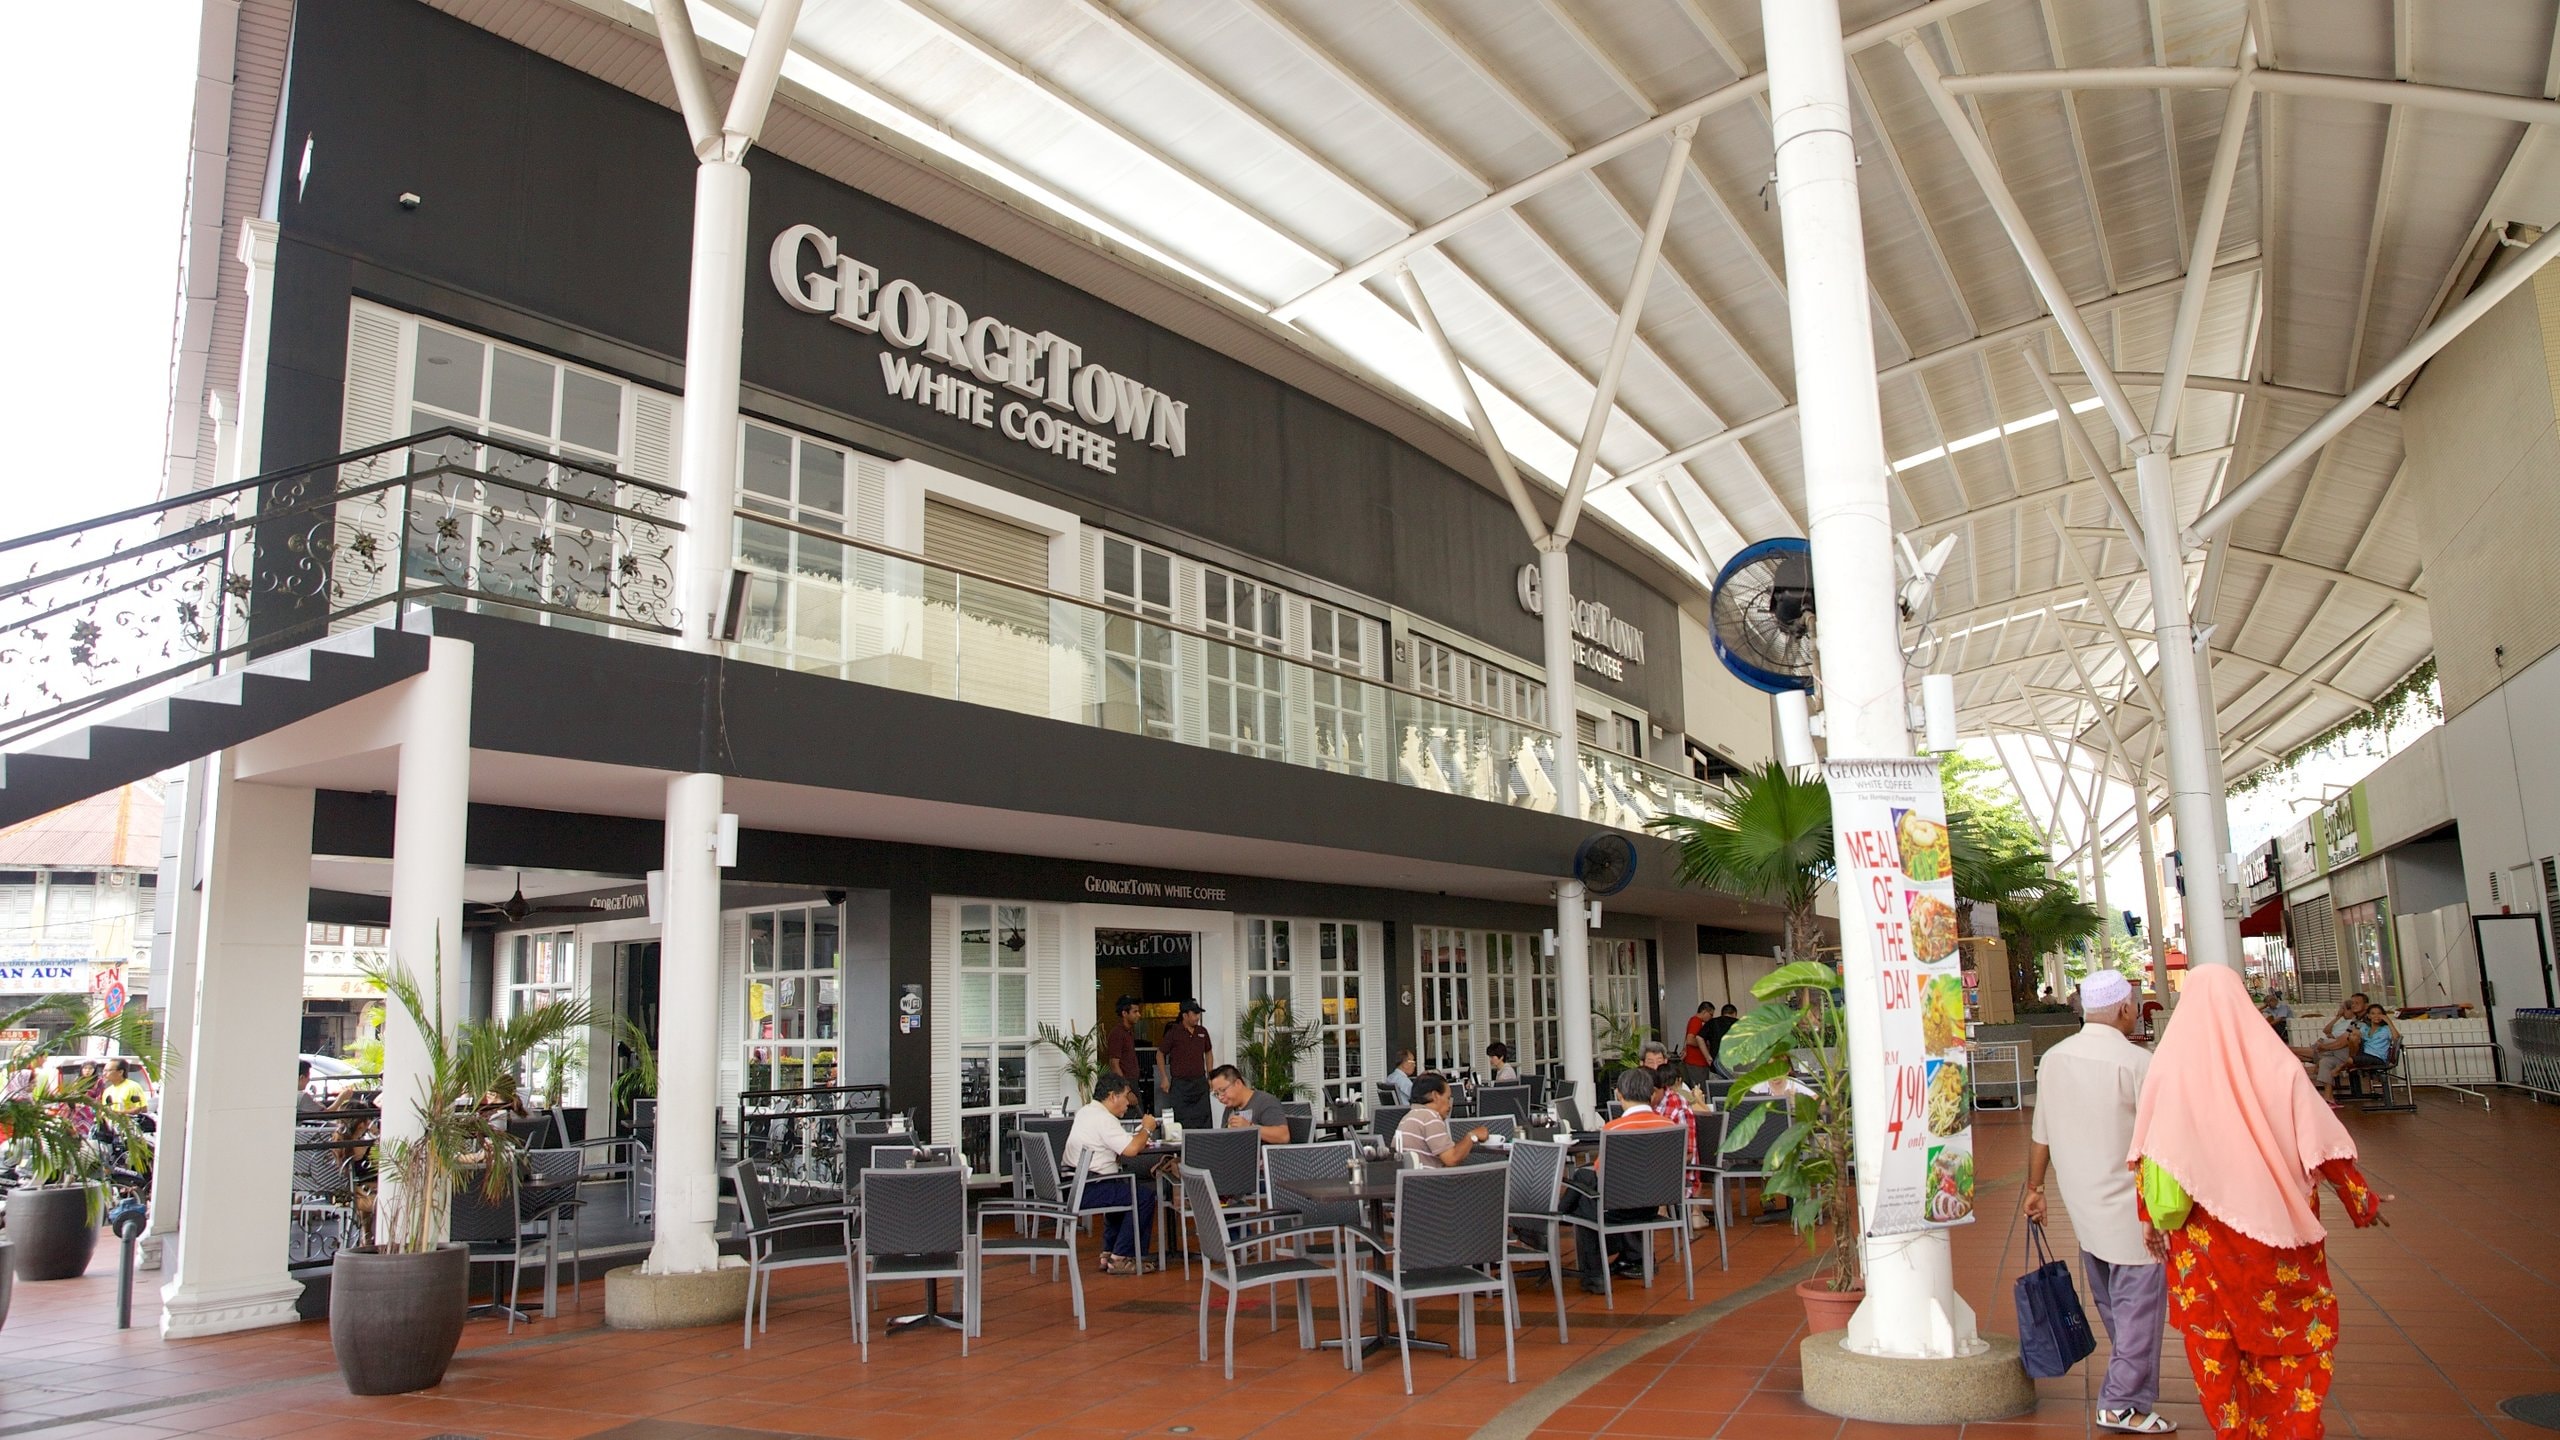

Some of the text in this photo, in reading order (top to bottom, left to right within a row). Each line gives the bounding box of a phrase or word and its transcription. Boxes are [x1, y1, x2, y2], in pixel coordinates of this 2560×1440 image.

[879, 351, 1117, 475] WHITE COFFEE
[1517, 563, 1645, 665] GRGETOWN
[1588, 647, 1623, 683] COFFEE
[1856, 779, 1913, 790] WHITE COFFEE
[1845, 830, 1899, 869] MEAL
[1164, 885, 1192, 899] WHITE
[1193, 887, 1226, 901] COFFEE
[1872, 875, 1894, 915] OF
[1876, 922, 1908, 962] THE
[31, 967, 73, 978] AUN
[1882, 969, 1911, 1010] DAY
[1884, 1051, 1899, 1066] RM
[1907, 1134, 1927, 1151] only
